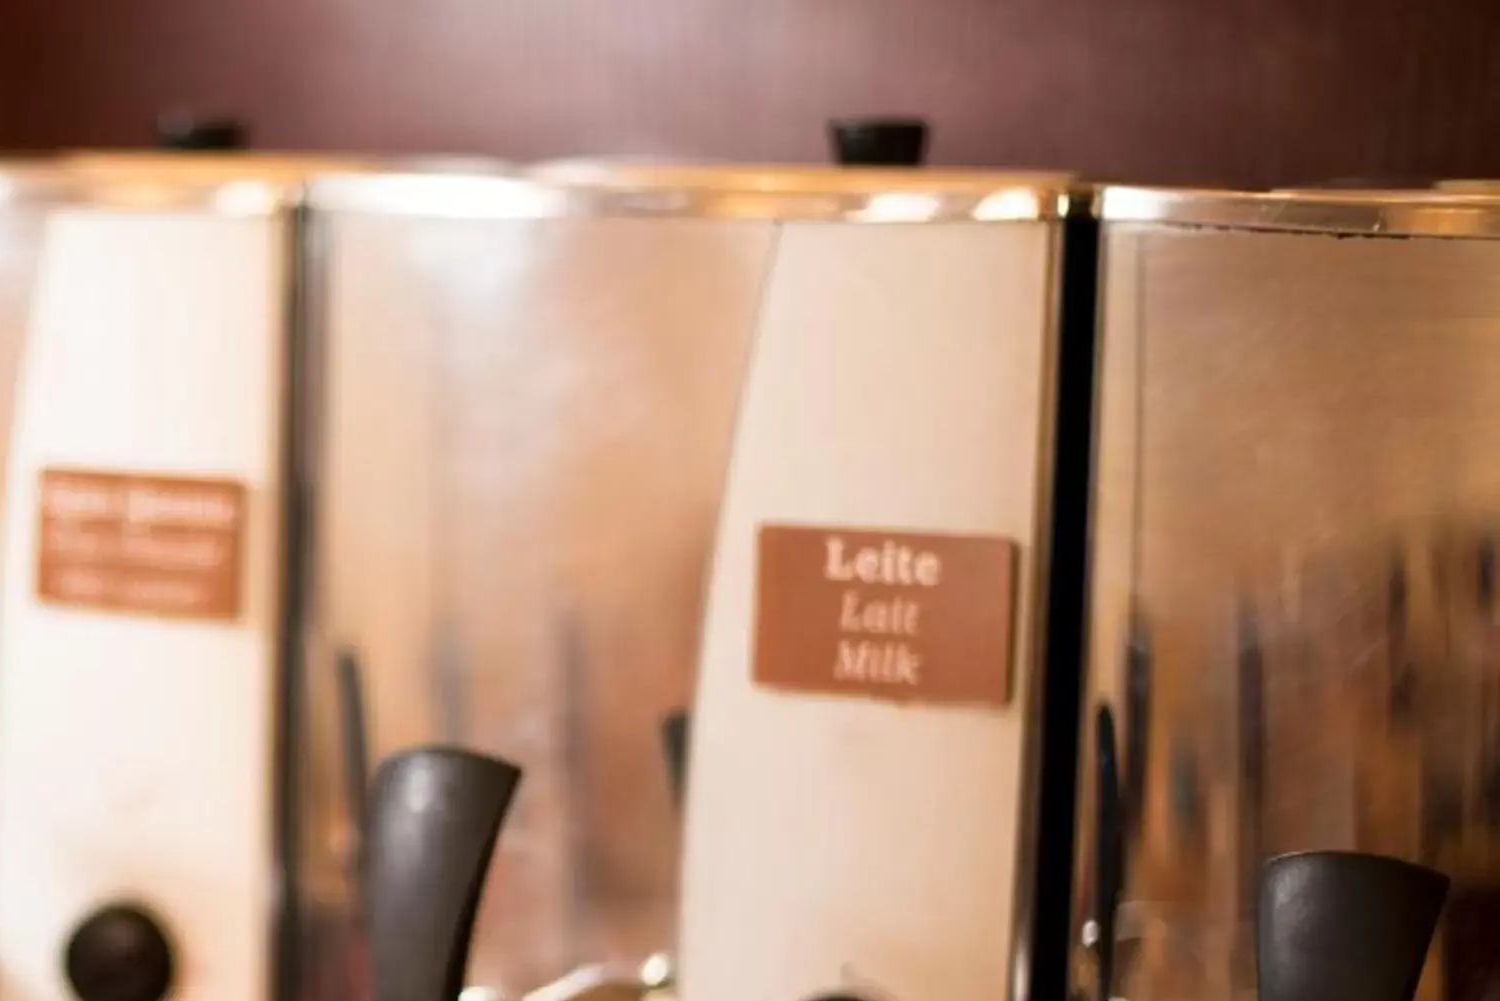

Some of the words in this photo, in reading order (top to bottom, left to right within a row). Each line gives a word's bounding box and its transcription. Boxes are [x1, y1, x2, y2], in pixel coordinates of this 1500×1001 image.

[823, 536, 941, 586] Leite
[840, 589, 920, 635] Lait
[833, 639, 922, 686] Milk
